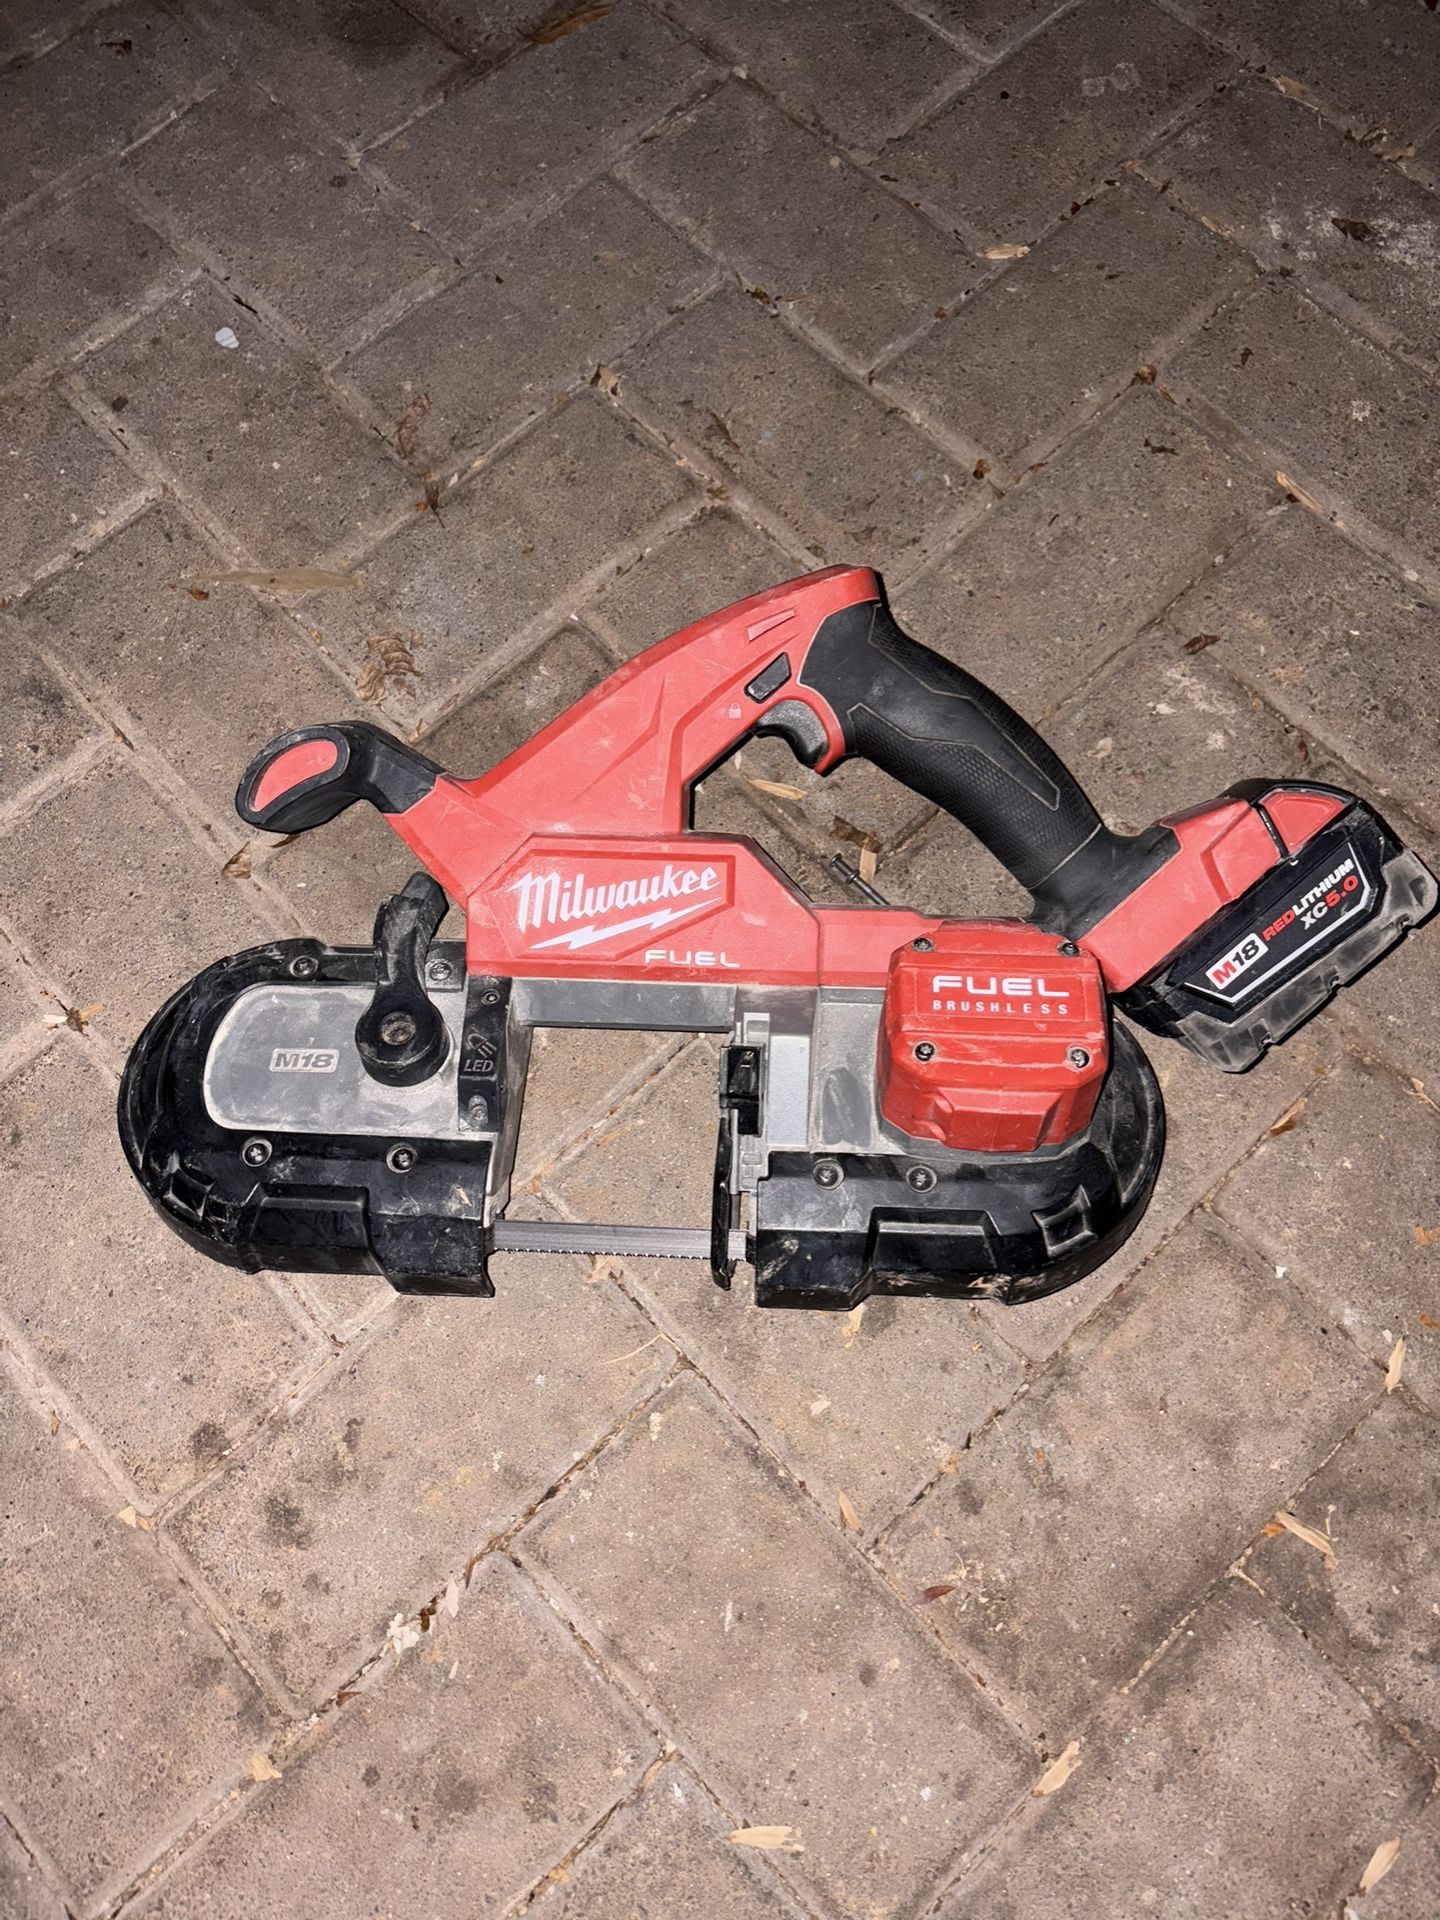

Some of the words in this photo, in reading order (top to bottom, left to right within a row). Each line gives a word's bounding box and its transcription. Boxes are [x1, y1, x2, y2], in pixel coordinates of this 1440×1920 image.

[505, 865, 721, 933] Milwaukee
[1300, 874, 1358, 930] XC5.0
[1212, 939, 1260, 984] M18
[1262, 858, 1355, 942] REDLITHIUM
[644, 949, 741, 968] FUEL
[932, 975, 1070, 997] FUEL
[932, 1000, 1068, 1015] BRUSHLESS
[274, 1053, 334, 1069] M18
[463, 1060, 494, 1072] LED
